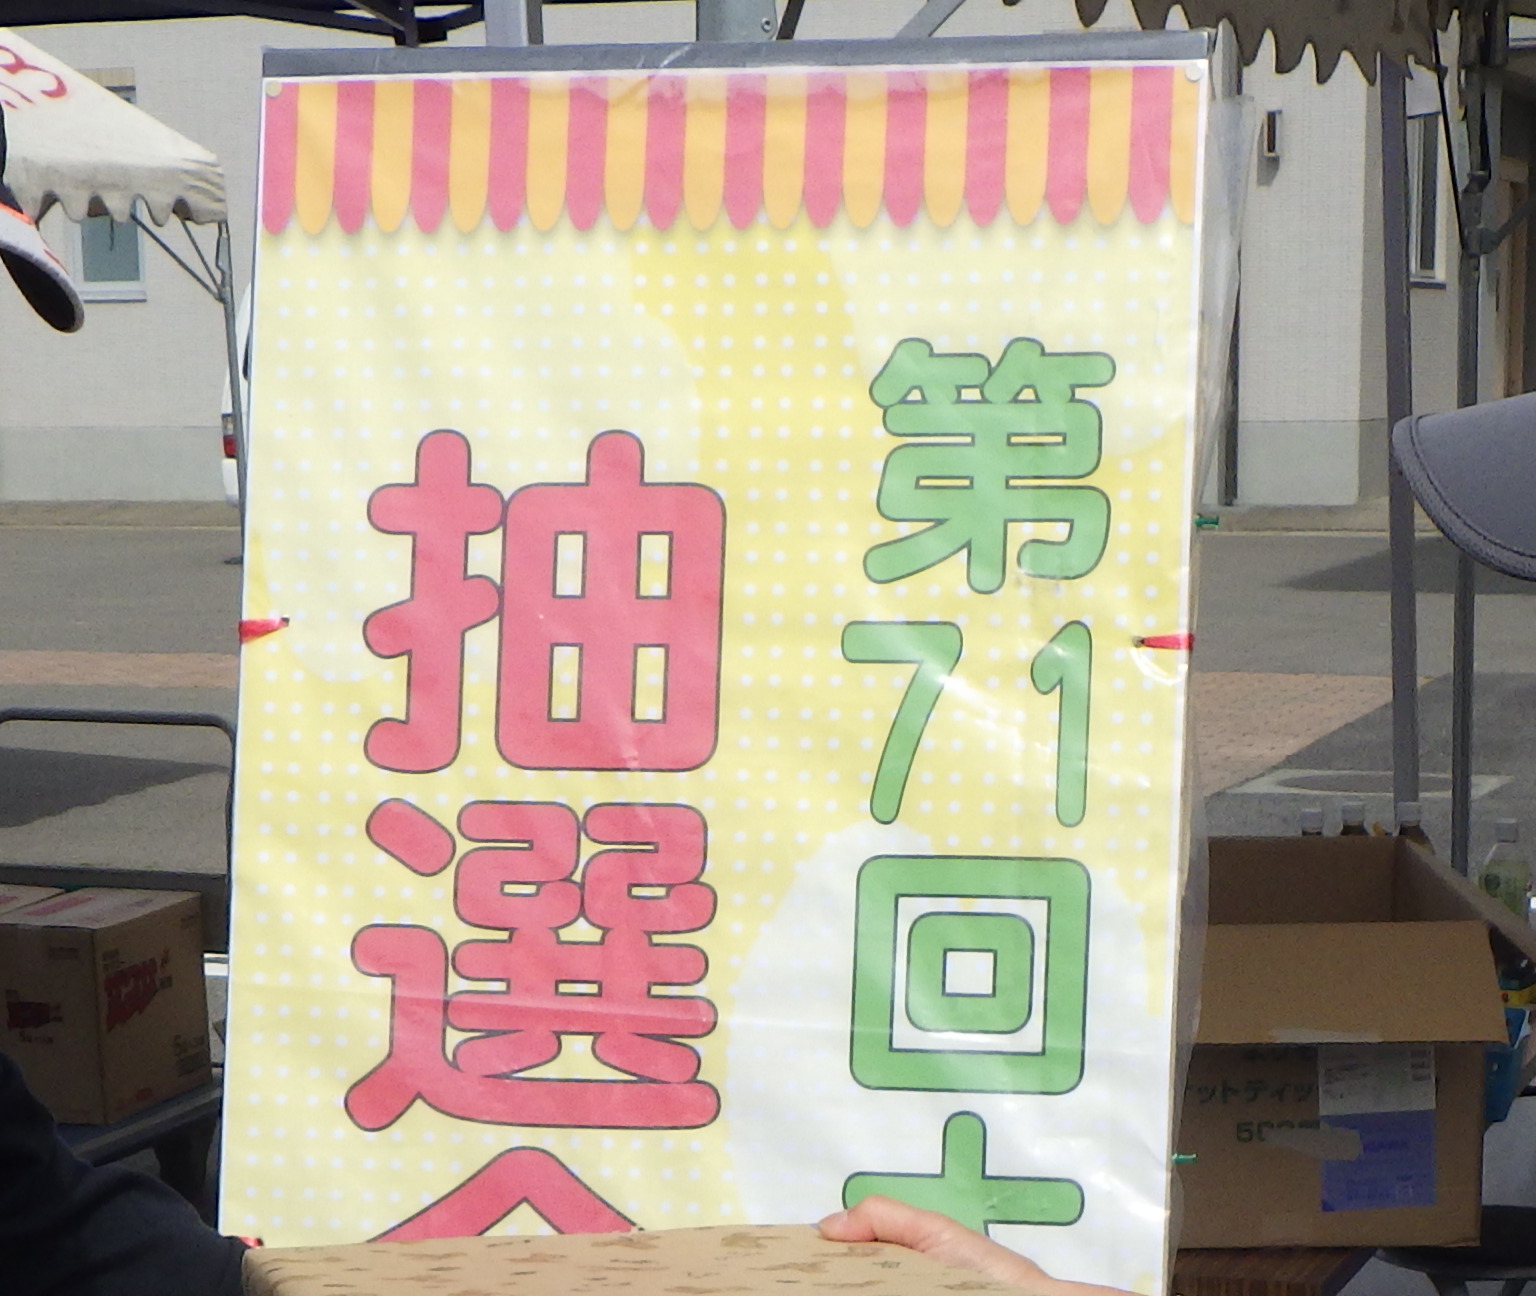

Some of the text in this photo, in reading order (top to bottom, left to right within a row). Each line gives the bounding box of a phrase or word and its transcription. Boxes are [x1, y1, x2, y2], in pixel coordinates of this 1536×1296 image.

[344, 428, 727, 1244] 抽選
[1186, 1077, 1319, 1104] ットティッ
